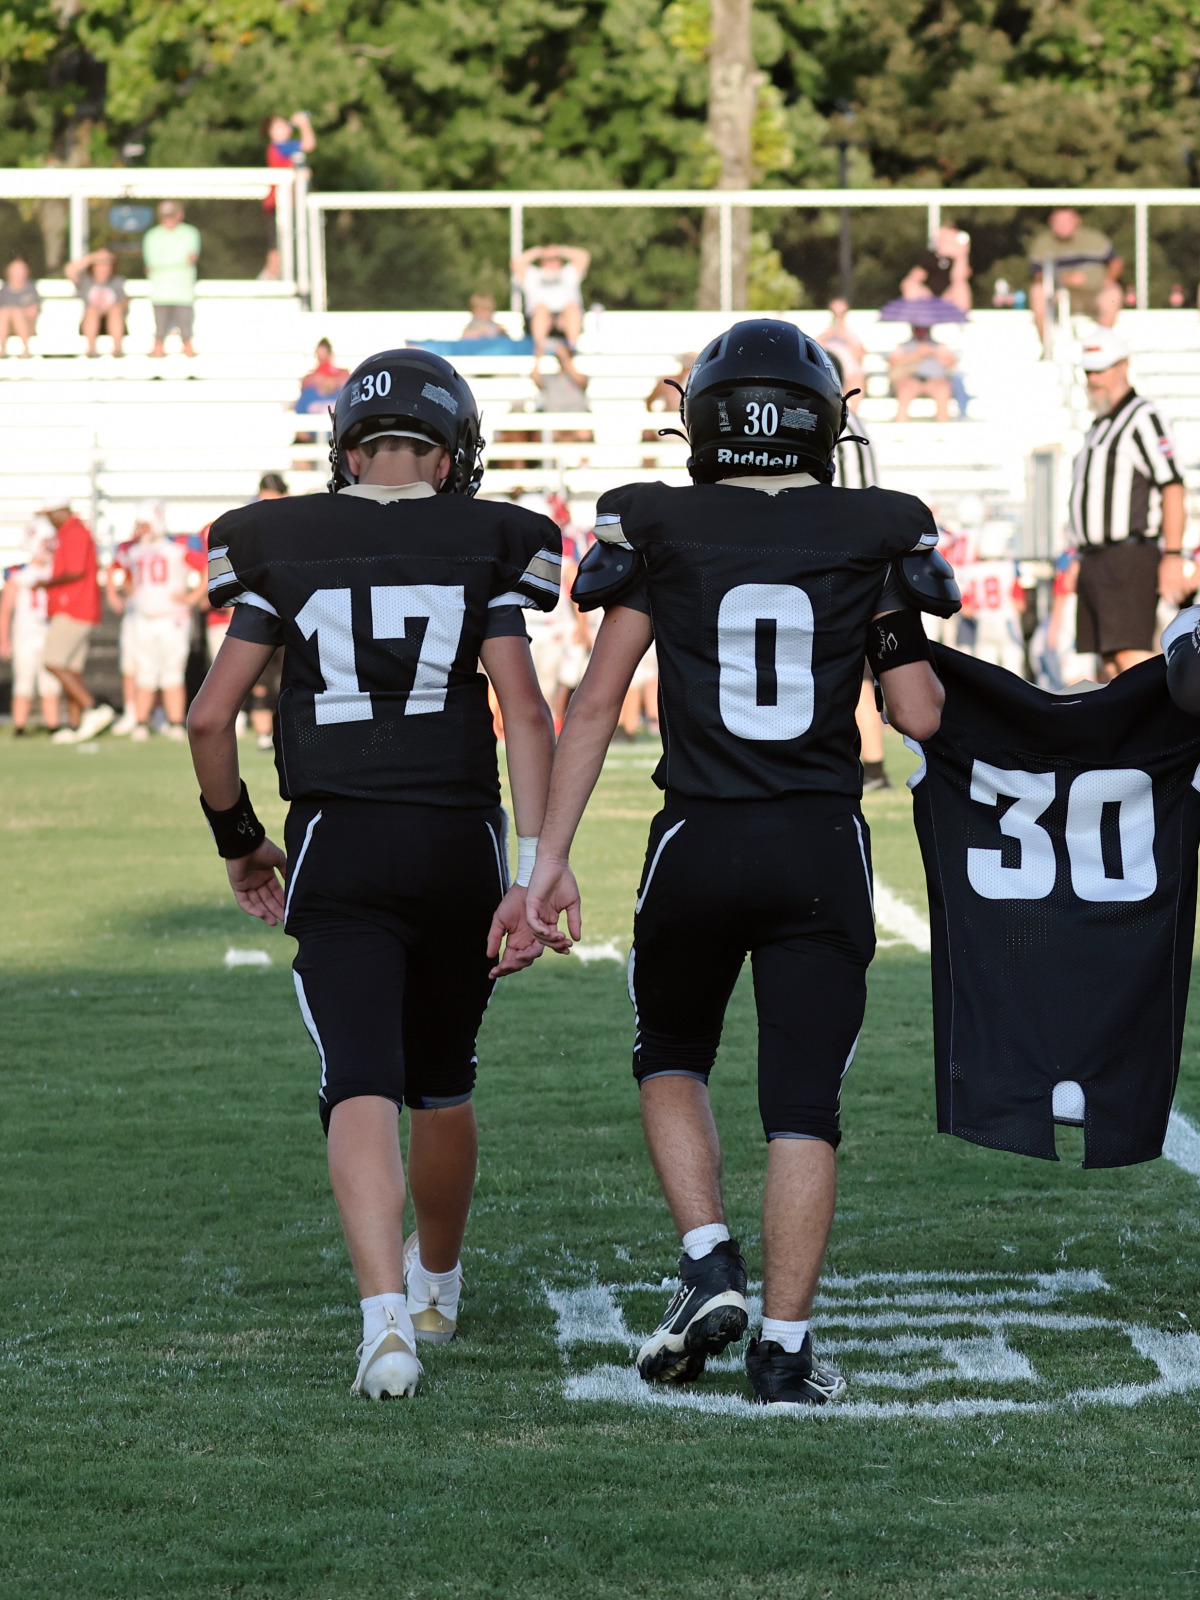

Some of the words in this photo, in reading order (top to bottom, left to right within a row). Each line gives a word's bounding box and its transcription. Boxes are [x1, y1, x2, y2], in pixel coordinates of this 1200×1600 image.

[361, 370, 392, 402] 30
[743, 401, 779, 437] 30
[717, 448, 799, 468] Riddell
[294, 584, 465, 725] 17
[717, 583, 815, 741] 0
[966, 758, 1159, 903] 30
